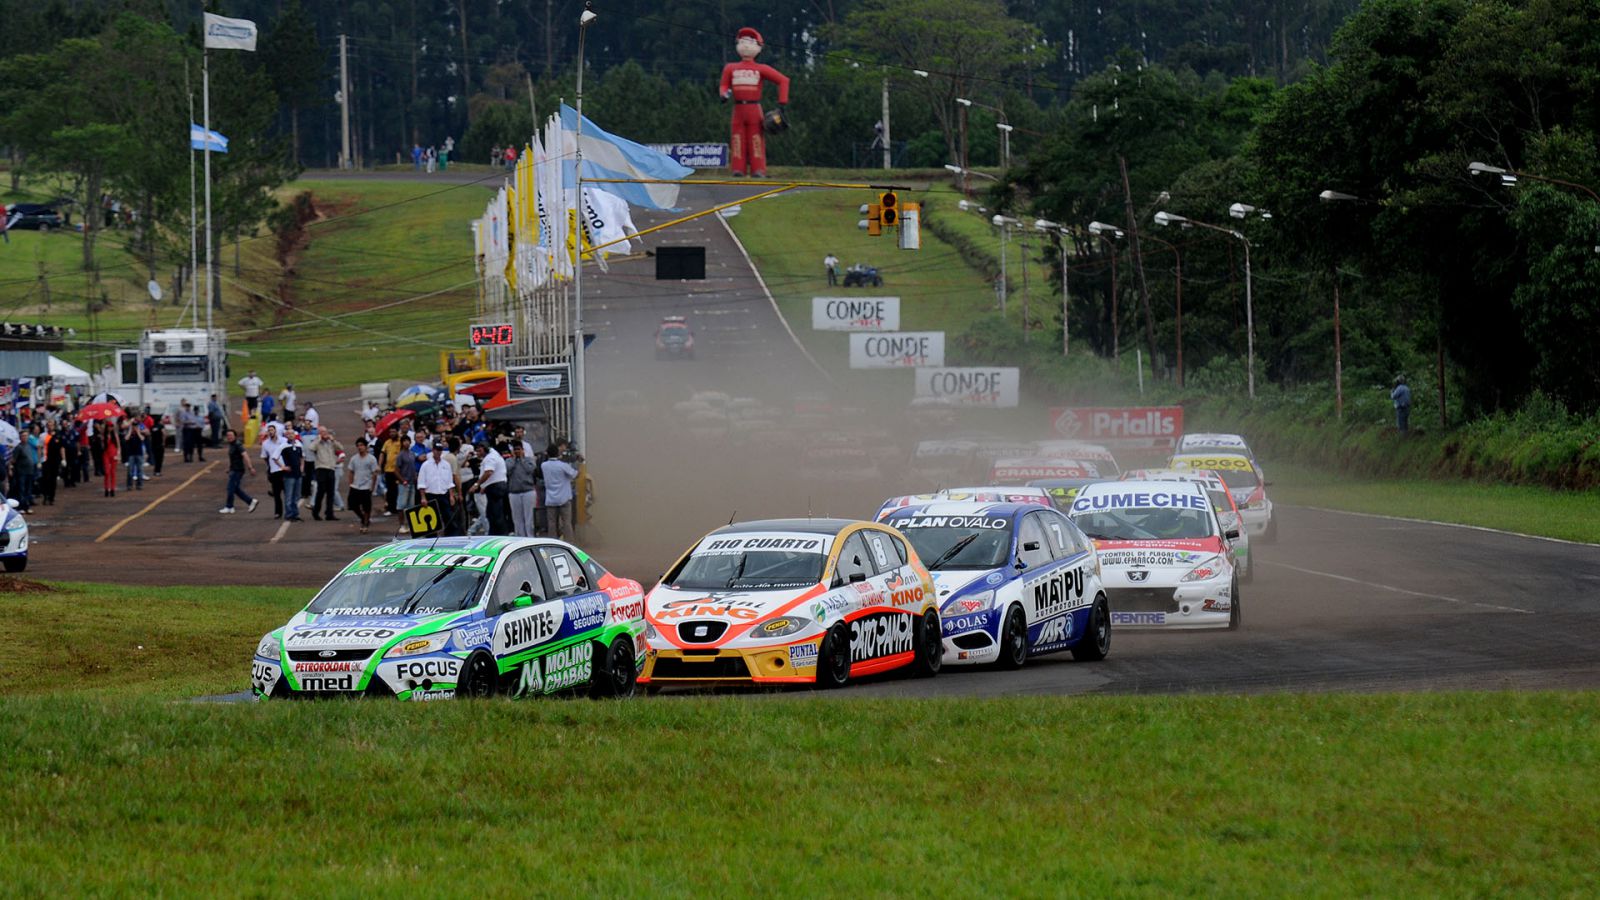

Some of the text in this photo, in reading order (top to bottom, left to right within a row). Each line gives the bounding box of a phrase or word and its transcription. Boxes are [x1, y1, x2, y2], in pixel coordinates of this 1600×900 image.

[826, 301, 885, 320] CONDE
[865, 337, 929, 358] CONDE
[930, 372, 1001, 394] CONDE
[1191, 459, 1246, 468] DOGO
[1073, 493, 1206, 511] CUMECHE
[895, 516, 1007, 529] PLAN OVALO
[707, 538, 819, 550] RIO CUARTO
[1051, 523, 1065, 549] 7
[871, 535, 889, 568] 8
[551, 555, 573, 588] 2
[890, 586, 924, 607] KING
[414, 606, 443, 615] GNC
[610, 601, 643, 624] Forcam
[654, 604, 760, 620] KING
[1111, 612, 1166, 624] PENTRE
[573, 611, 605, 631] SEGUROS
[957, 614, 988, 630] OLAS
[288, 629, 395, 641] MARIGO
[545, 640, 593, 676] MOLINO
[790, 643, 818, 658] PUNTAL
[295, 662, 350, 672] PETROROLDAN
[397, 661, 458, 679] FOCUS
[302, 674, 352, 689] med
[544, 660, 593, 694] CHABAS
